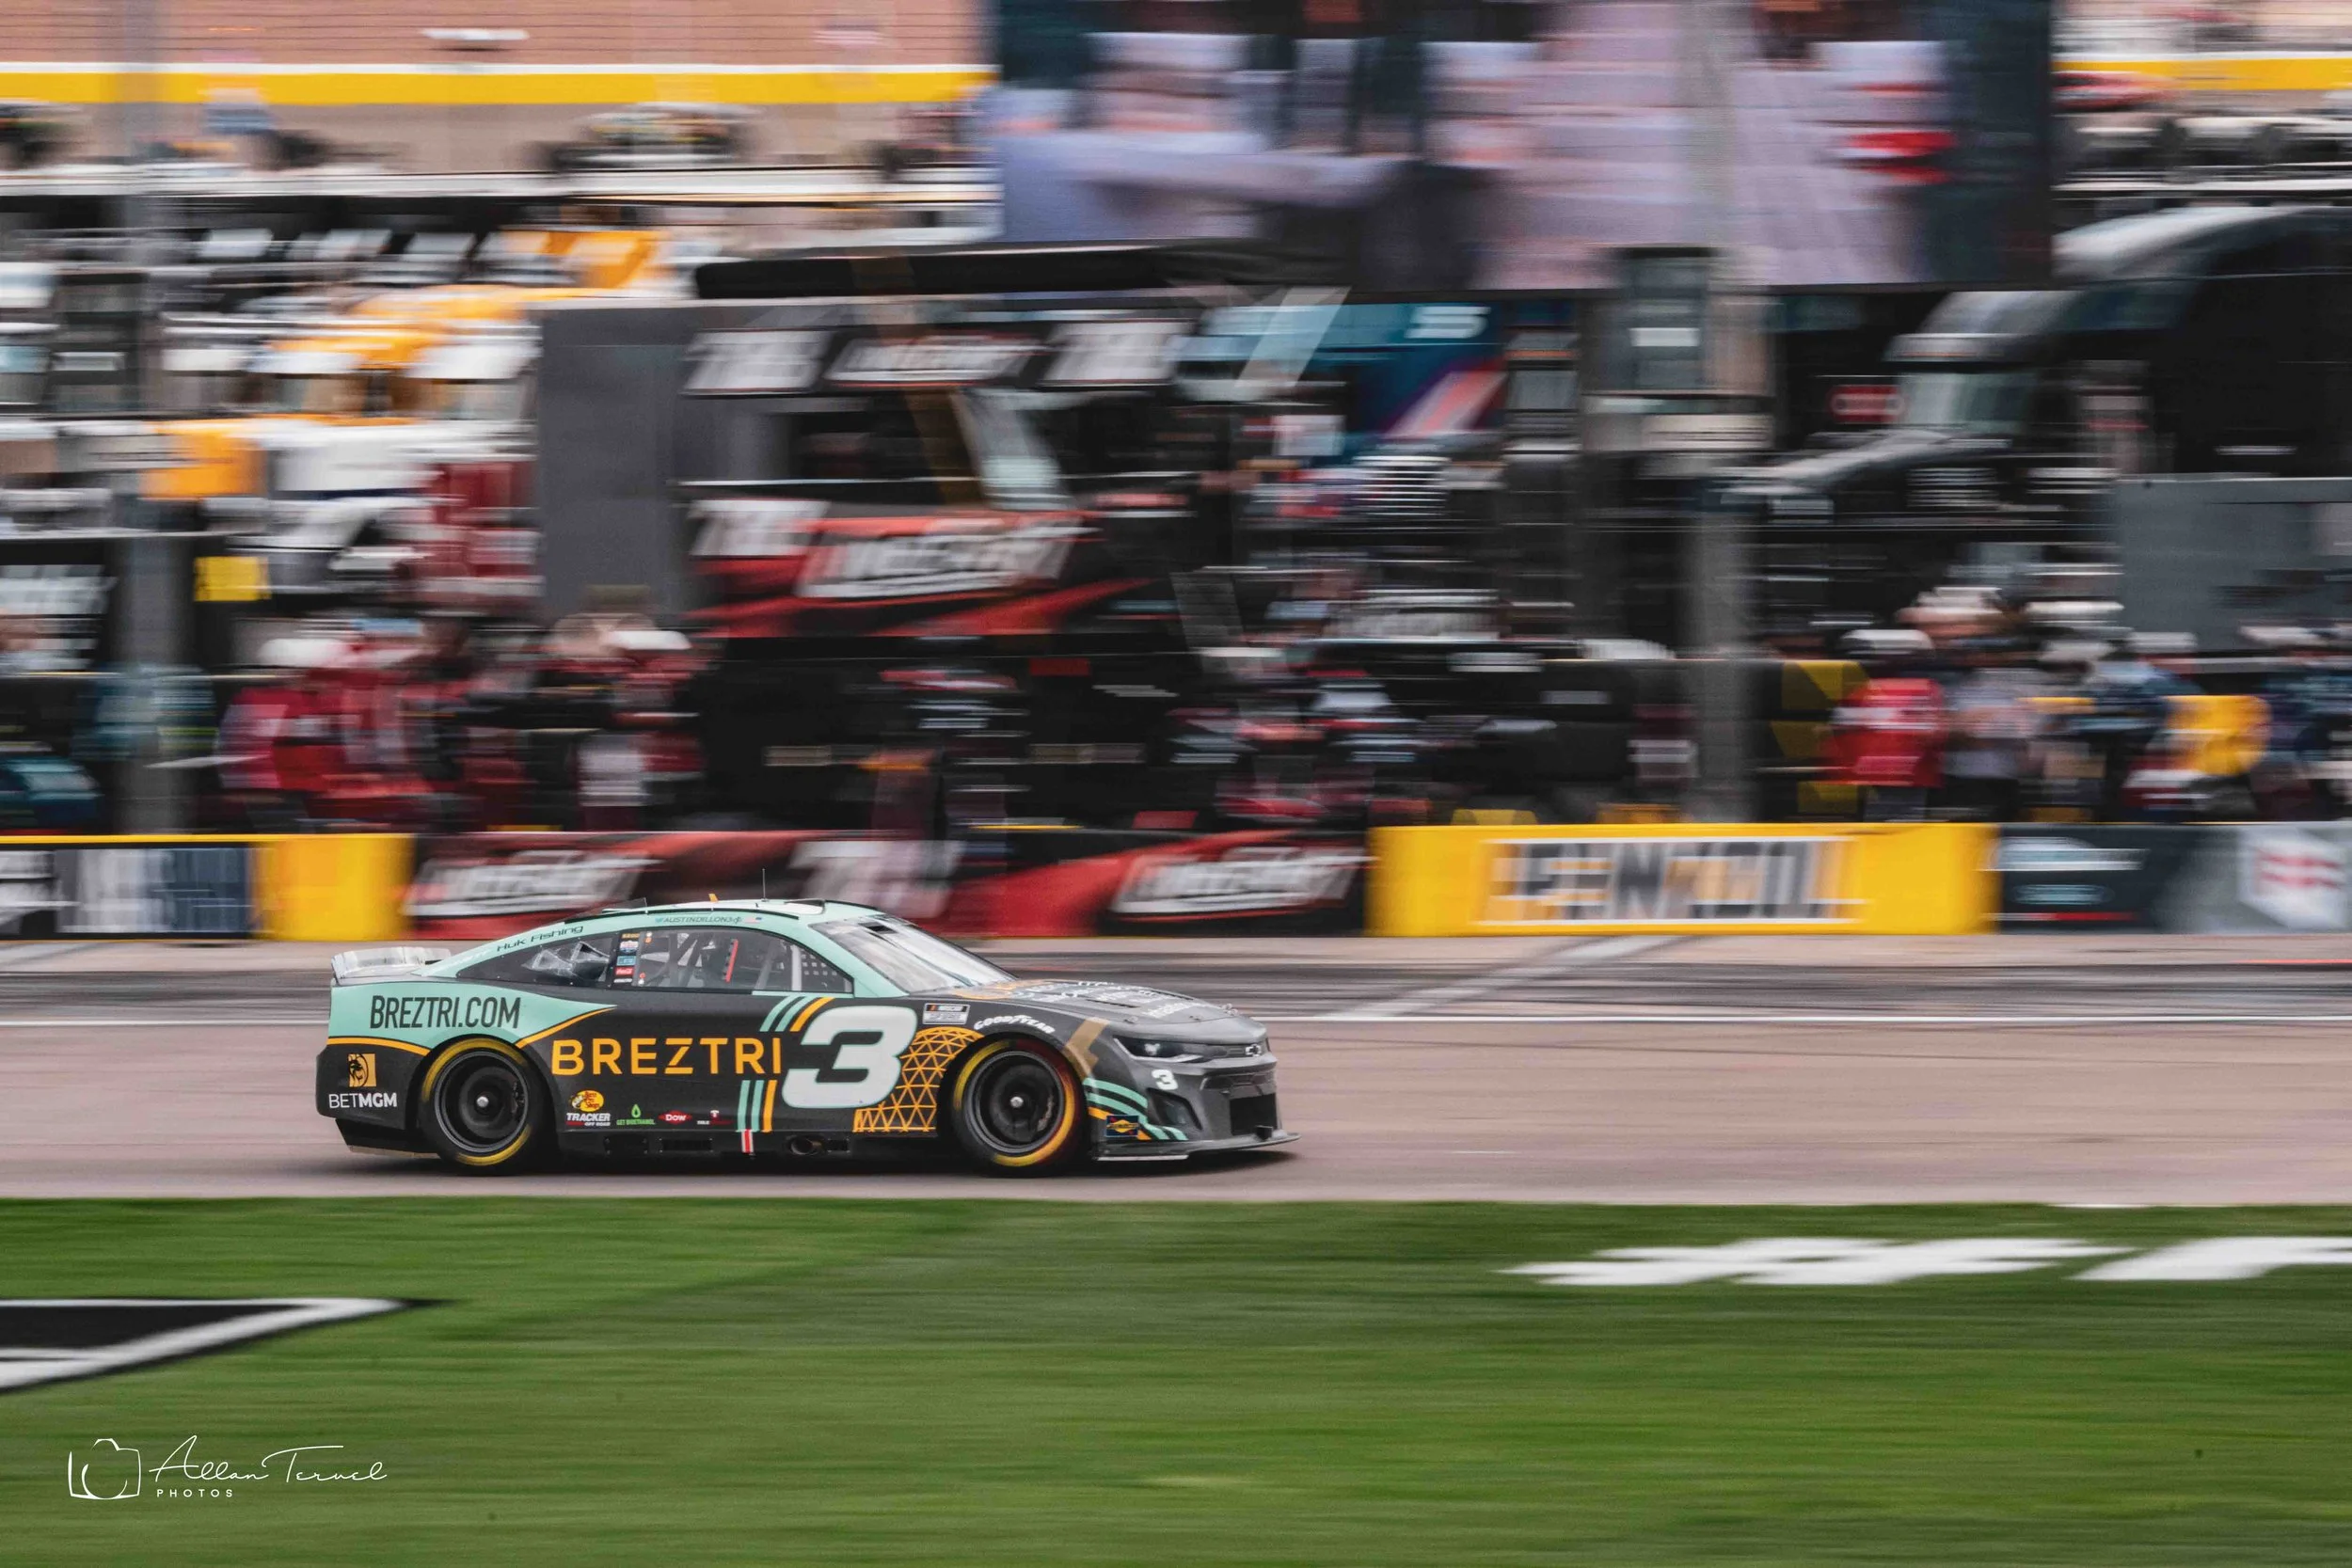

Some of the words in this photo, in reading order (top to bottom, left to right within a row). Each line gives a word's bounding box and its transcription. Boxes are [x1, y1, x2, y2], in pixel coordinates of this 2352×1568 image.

[497, 940, 526, 952] Huk
[531, 926, 583, 942] Fishing
[370, 995, 521, 1029] BREZTRI.COM
[550, 1037, 782, 1076] BREZTRI
[782, 1006, 917, 1109] 3
[1152, 1069, 1179, 1091] 3
[328, 1092, 398, 1109] BETMGM
[566, 1112, 611, 1121] TRACKER
